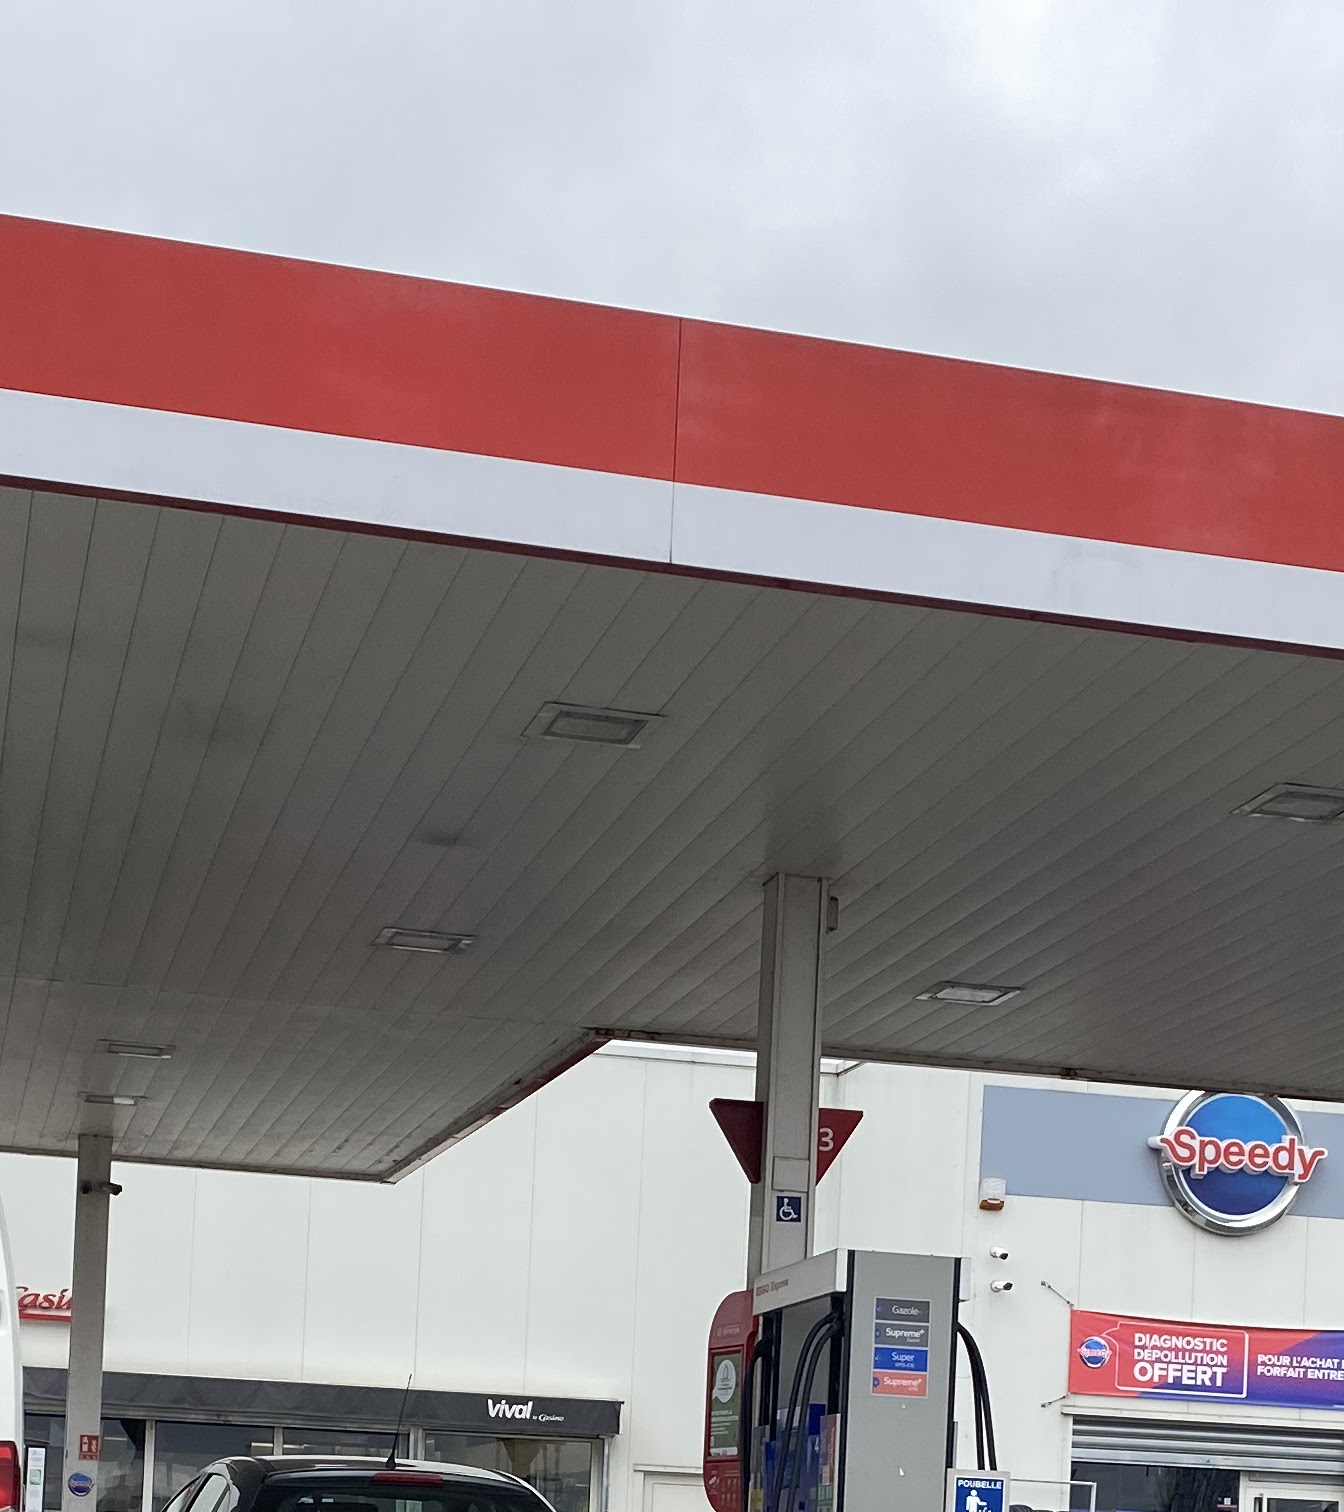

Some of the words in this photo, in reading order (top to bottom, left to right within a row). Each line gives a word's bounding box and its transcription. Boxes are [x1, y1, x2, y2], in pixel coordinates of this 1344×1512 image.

[818, 1127, 834, 1152] 3
[1159, 1127, 1326, 1183] Speedy
[1133, 1333, 1228, 1352] DIAGNOSTIC
[1257, 1354, 1292, 1367] POUR
[1293, 1356, 1340, 1369] L'ACHAT
[1133, 1363, 1228, 1387] OFFERT
[1257, 1365, 1306, 1379] FORFAIT
[487, 1398, 534, 1420] Vival
[957, 1479, 1003, 1490] POUBELLE
